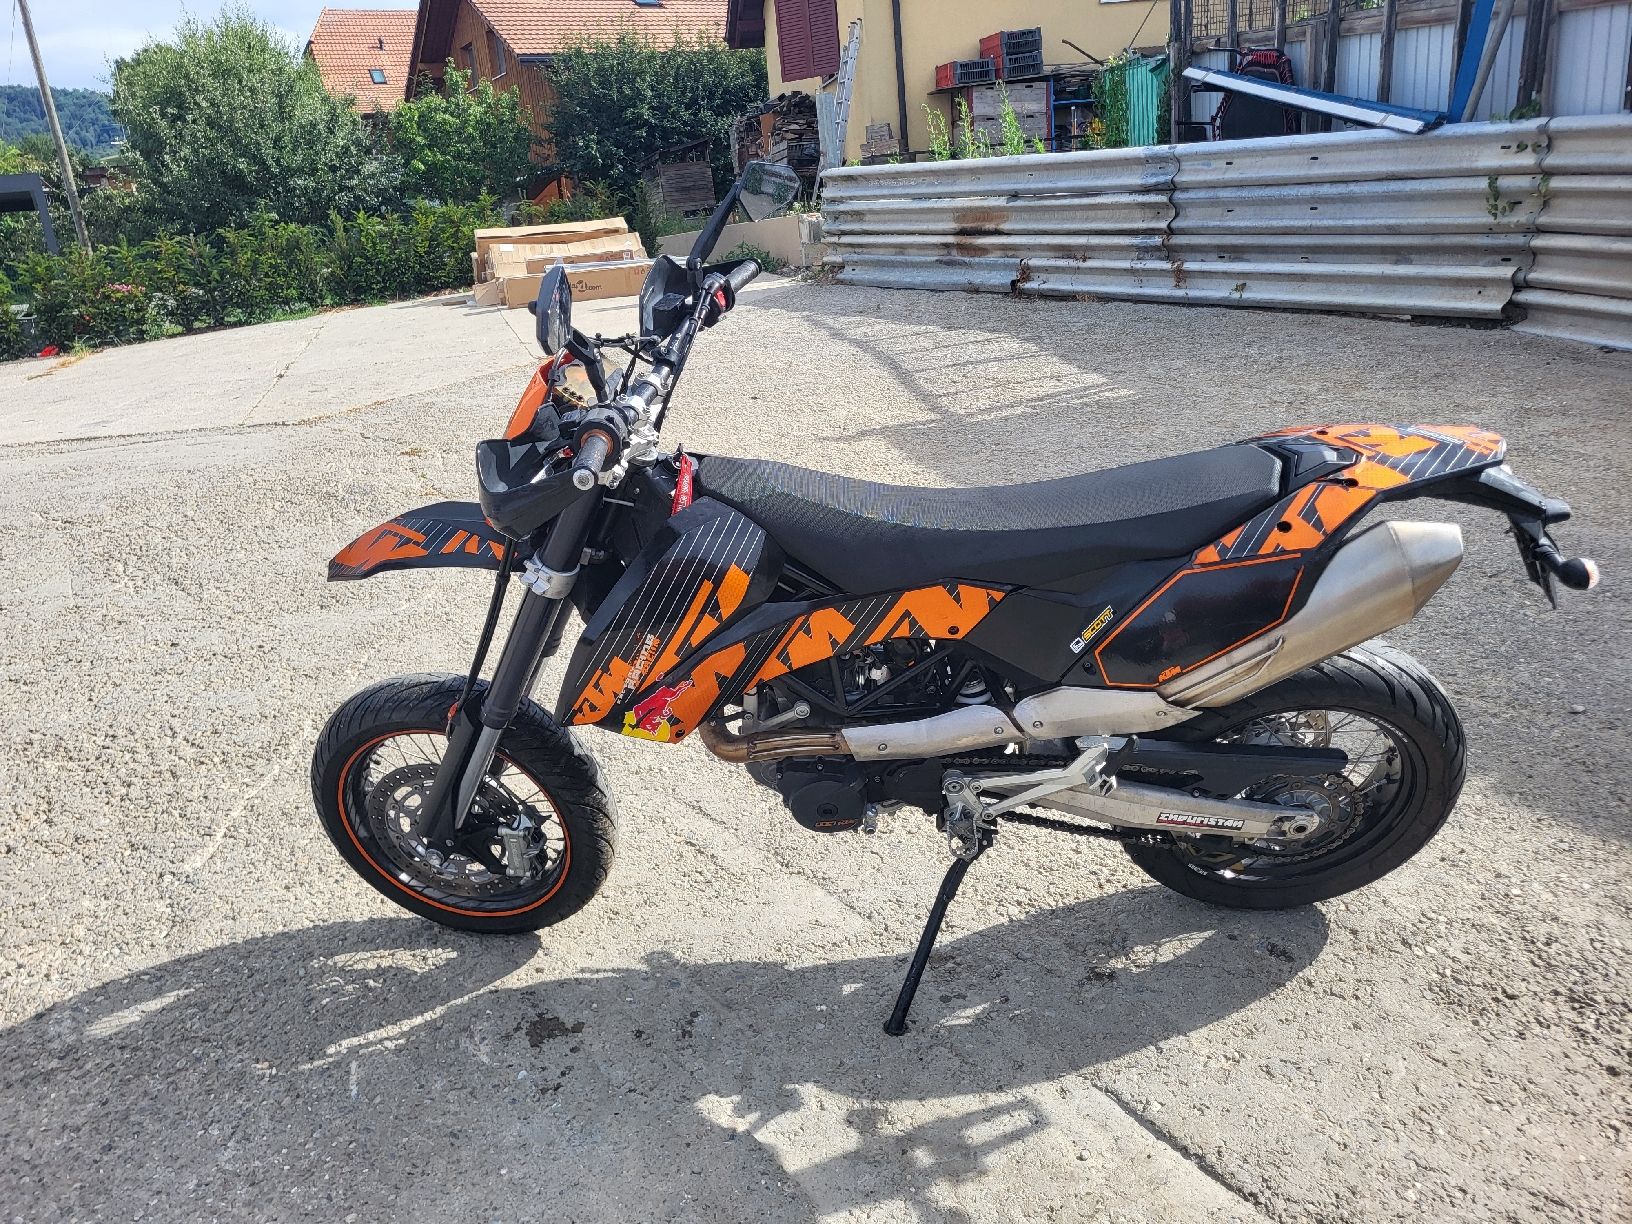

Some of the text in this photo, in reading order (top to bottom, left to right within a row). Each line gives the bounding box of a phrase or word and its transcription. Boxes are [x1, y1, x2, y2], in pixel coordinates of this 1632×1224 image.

[1082, 606, 1112, 642] SCOTT
[1158, 665, 1181, 683] KTM
[572, 656, 633, 725] KTM
[1159, 813, 1244, 828] ENDURISTAN
